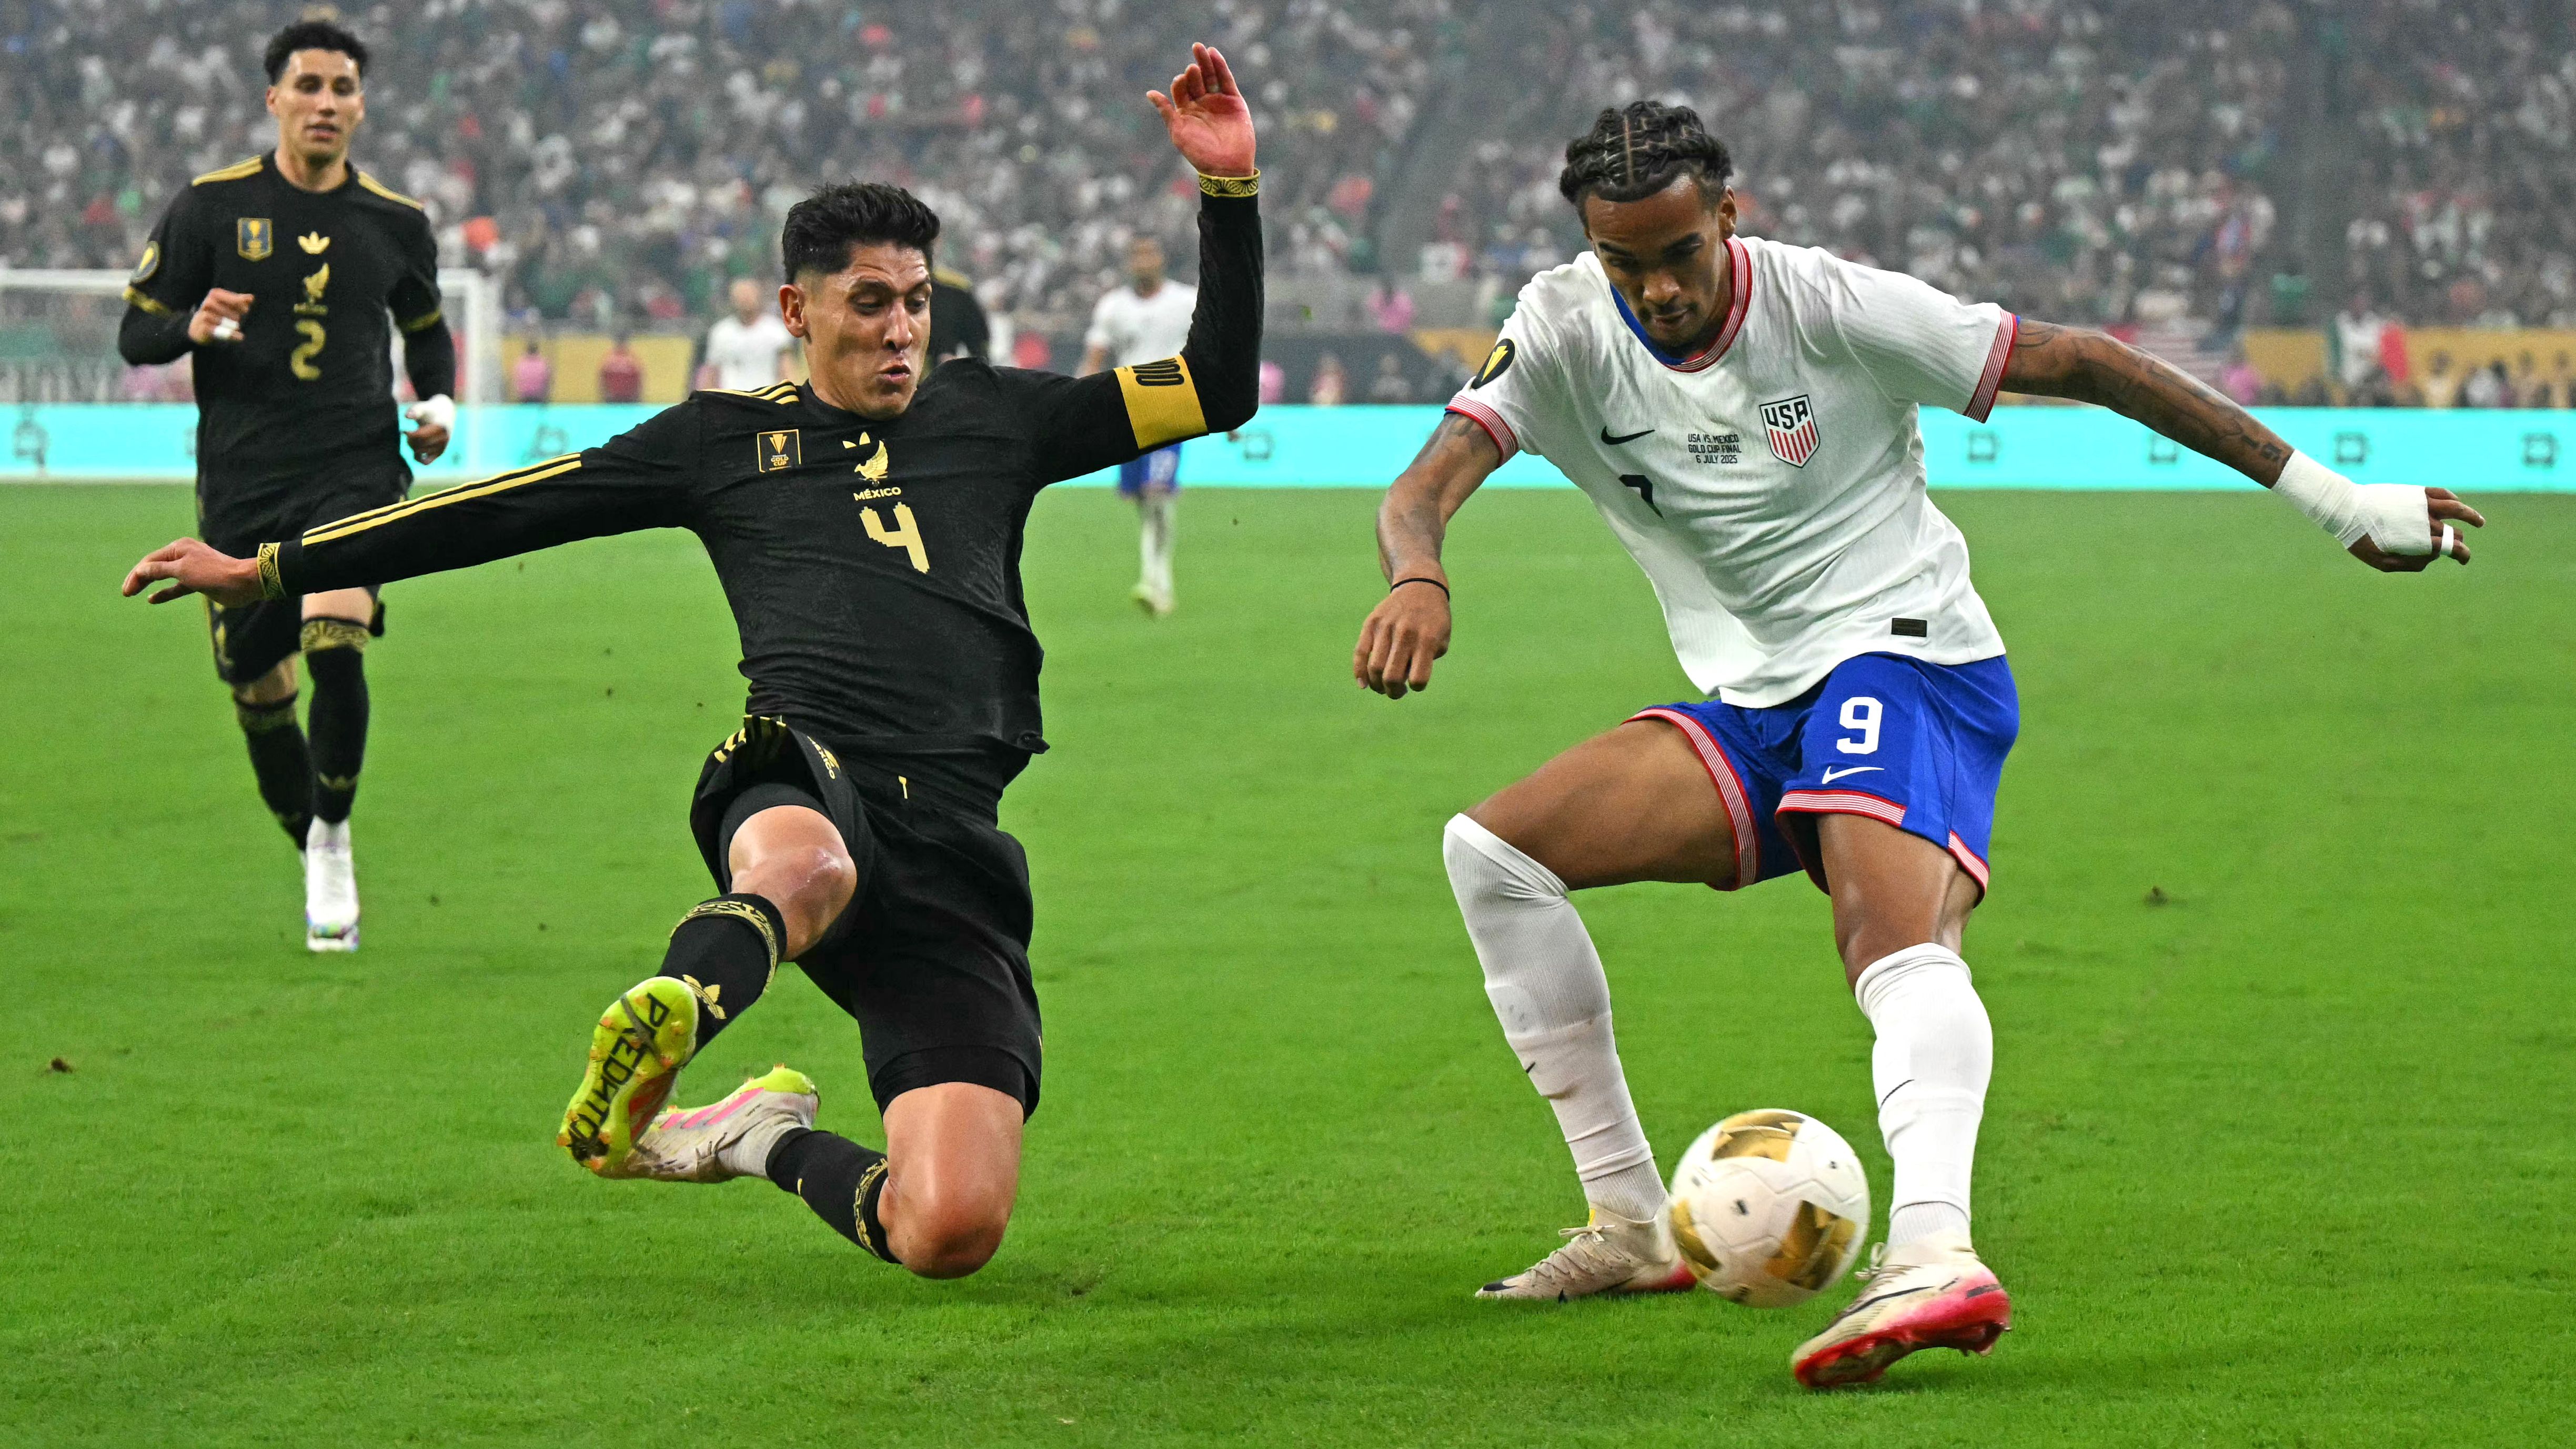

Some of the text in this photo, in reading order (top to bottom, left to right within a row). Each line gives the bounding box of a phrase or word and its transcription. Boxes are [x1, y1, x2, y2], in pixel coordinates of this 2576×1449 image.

[291, 319, 326, 381] 2
[1764, 400, 1808, 430] USA
[1688, 434, 1701, 442] USA
[1713, 434, 1739, 444] MEXICO
[1688, 444, 1742, 454] GOLD CUP FINAL
[1696, 455, 1738, 464] 6 JULY 2025
[853, 487, 902, 501] MÉXICO
[859, 501, 930, 575] 4
[1836, 697, 1883, 754] 9
